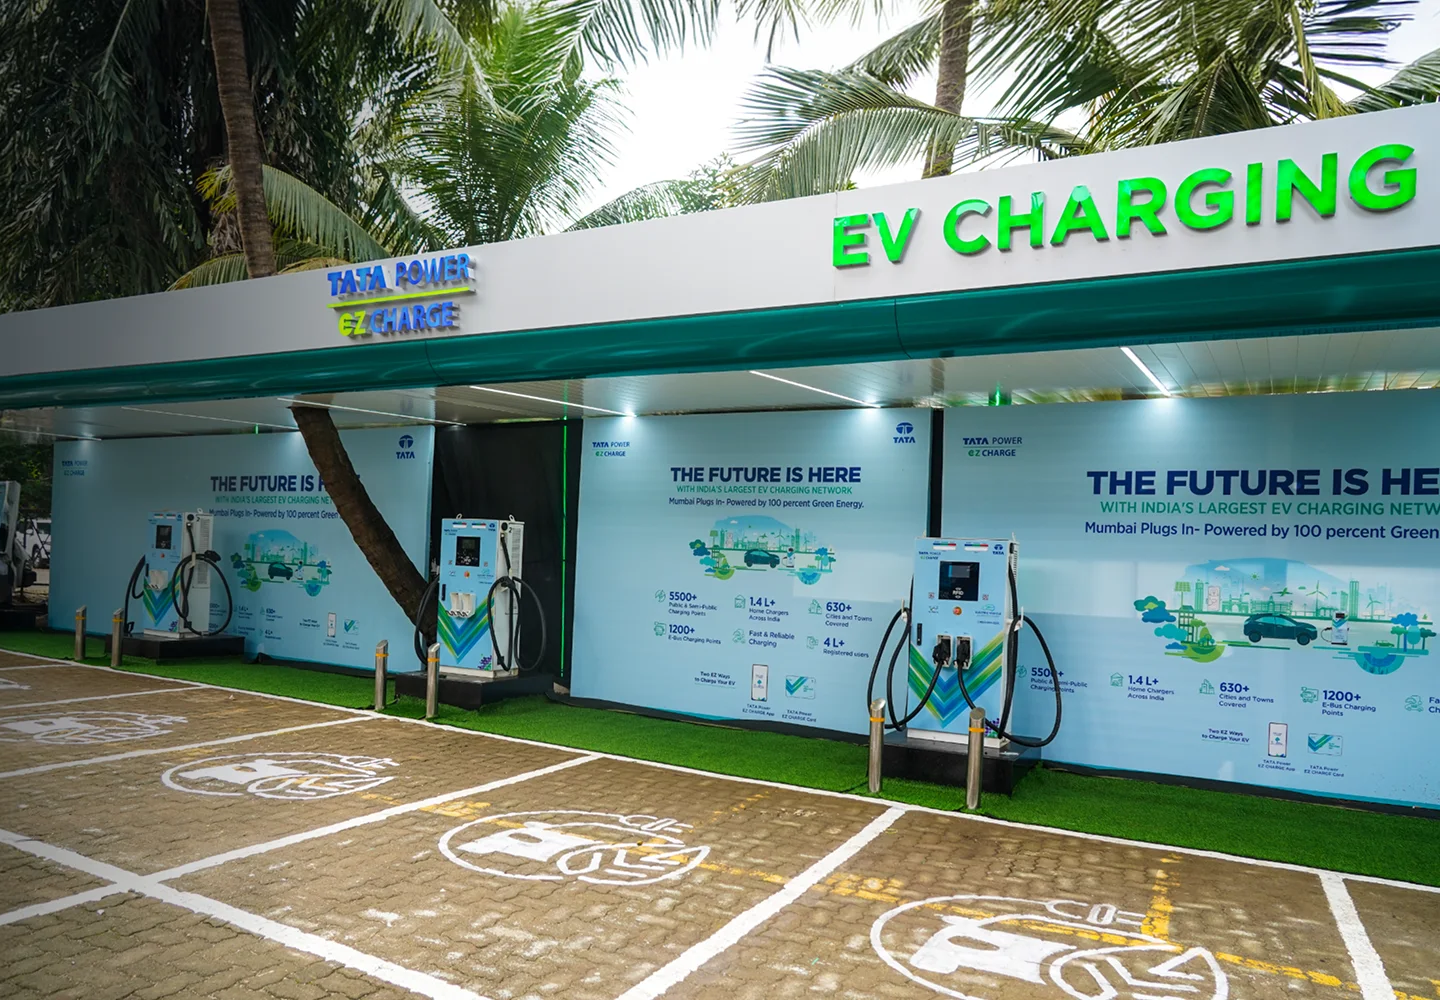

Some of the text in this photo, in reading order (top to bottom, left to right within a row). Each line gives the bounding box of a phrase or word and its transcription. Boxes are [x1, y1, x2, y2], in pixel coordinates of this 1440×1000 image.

[832, 143, 1418, 267] EV CHARGING
[327, 253, 471, 296] TATA POWER
[370, 302, 453, 333] CHARGE
[992, 437, 1022, 445] POWER
[396, 451, 415, 459] TATA
[982, 449, 1016, 457] CHARGE
[671, 467, 861, 483] THE FUTURE IS HERE
[210, 476, 237, 492] THE
[240, 475, 297, 492] FUTURE
[301, 475, 314, 492] IS
[1087, 471, 1156, 495] THE
[1167, 470, 1320, 495] FUTURE
[1333, 469, 1369, 496] IS
[724, 486, 756, 494] LARGEST
[758, 486, 768, 494] EV
[770, 486, 810, 494] CHARGING
[812, 486, 852, 494] NETWORK
[215, 496, 230, 504] WITH
[251, 496, 277, 504] LARGEST
[278, 496, 286, 504] EV
[287, 496, 319, 504] CHARGING
[669, 497, 864, 509] Mumbai Plugs In- Powered by 100 percent Green Energy.
[209, 508, 229, 517] Mumbai
[230, 509, 244, 518] Plugs
[278, 510, 285, 519] by
[286, 510, 297, 518] 100
[298, 510, 319, 519] percent
[321, 511, 338, 519] Green
[1100, 502, 1137, 513] WITH
[1141, 502, 1193, 514] INDIA'S
[1199, 502, 1266, 515] LARGEST
[1272, 503, 1292, 514] EV
[1297, 502, 1384, 515] CHARGING
[1085, 522, 1439, 540] Mumbai Plugs In- Powered by 100 percent Green
[669, 591, 697, 601] 5500+
[750, 597, 775, 607] 1.4 L+
[826, 602, 852, 612] 630+
[669, 624, 695, 634] 1200+
[683, 636, 705, 644] Charging
[749, 639, 777, 648] Charging
[824, 637, 844, 648] 4 L+
[1031, 667, 1064, 678] 550+
[1128, 675, 1159, 686] 1.4 L+
[1147, 687, 1174, 695] Chargers
[1220, 682, 1249, 693] 630+
[1323, 690, 1361, 701] 1200+
[1322, 702, 1376, 713] E-Bus Charging
[1322, 709, 1343, 717] Points
